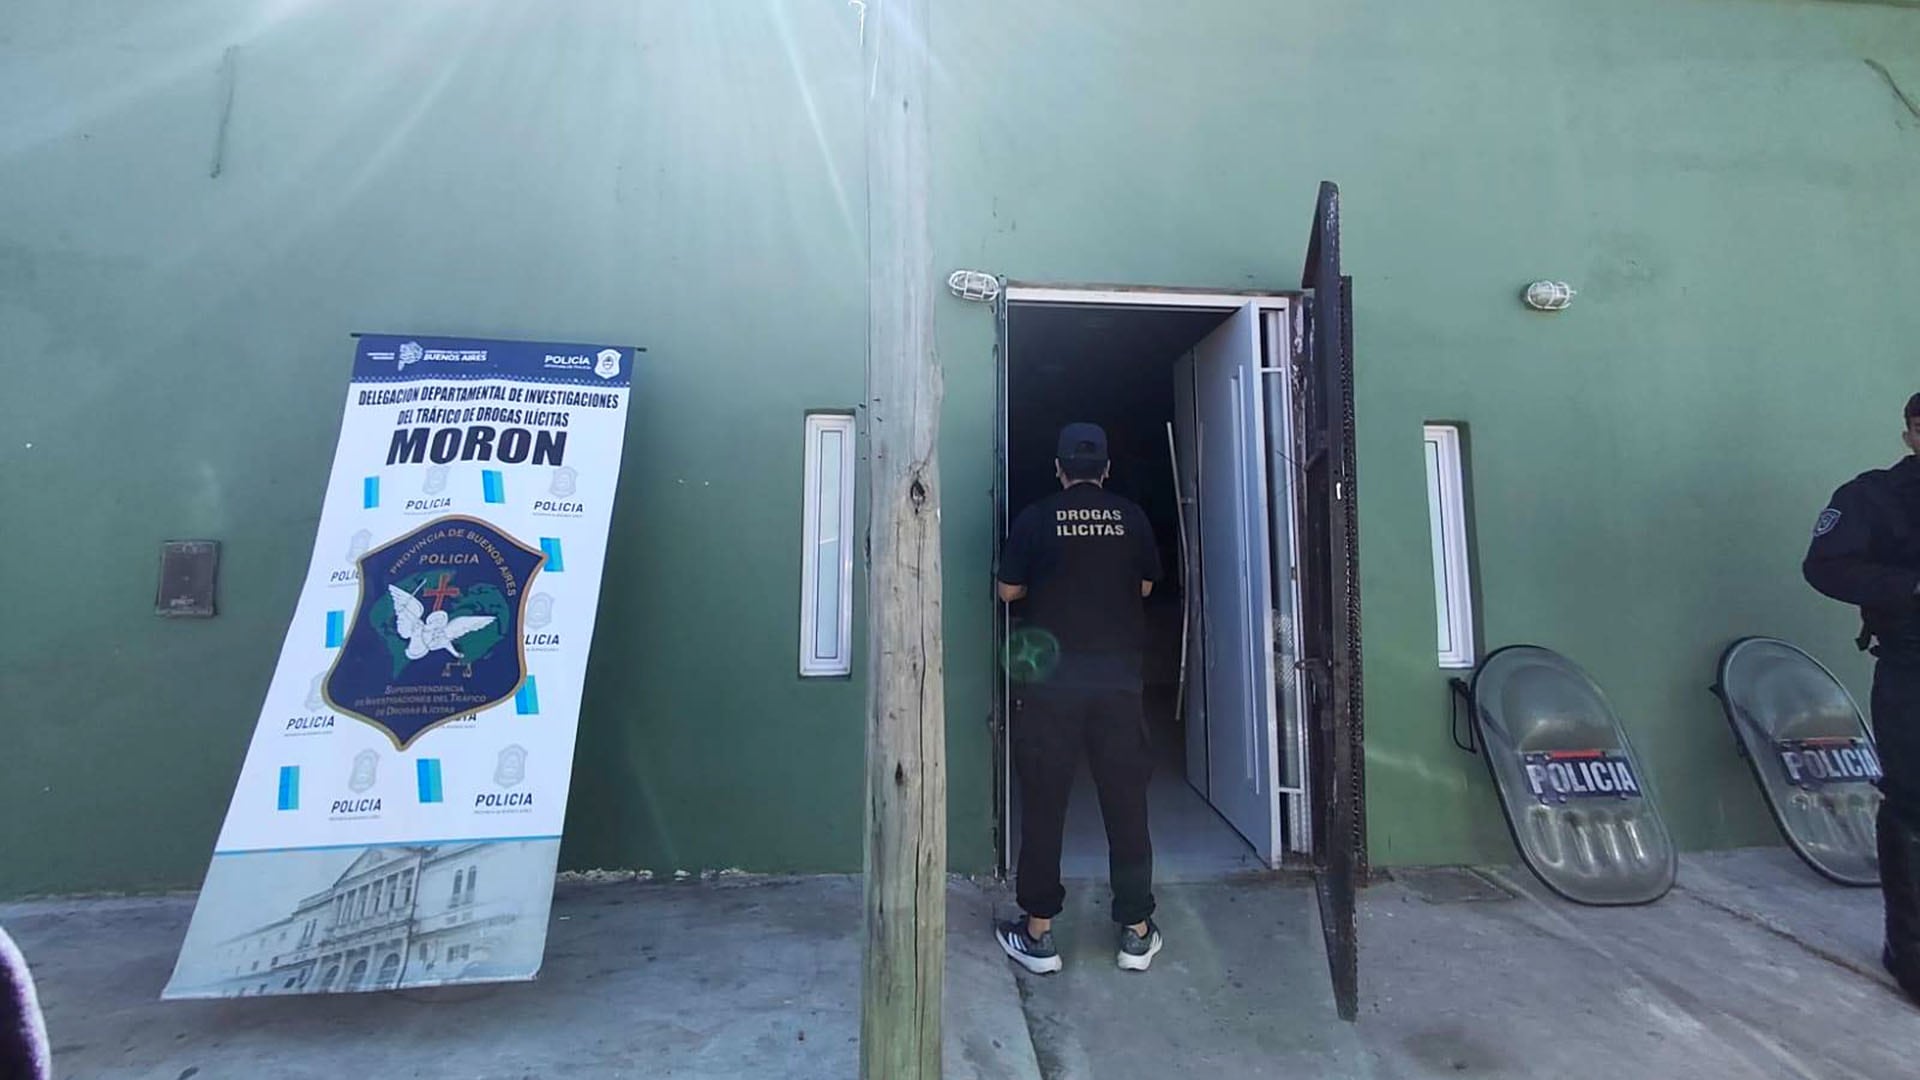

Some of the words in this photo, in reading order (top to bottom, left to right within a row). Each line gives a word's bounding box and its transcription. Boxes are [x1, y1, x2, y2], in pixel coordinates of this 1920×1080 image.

[423, 353, 460, 361] BUENOS
[420, 386, 506, 402] DEPARTAMENTAL
[508, 387, 524, 402] DE
[524, 389, 619, 409] INVESTIGACIONES
[397, 409, 414, 425] DEL
[415, 406, 462, 424] TRÁFICO
[462, 408, 476, 422] DE
[475, 407, 522, 424] DROGAS
[523, 408, 570, 428] ILÍCITAS
[386, 426, 567, 467] MORON
[405, 498, 451, 510] POLICIA
[534, 501, 584, 513] POLICIA
[1056, 509, 1122, 521] DROGAS
[1056, 524, 1125, 536] ILICITAS
[390, 529, 445, 574] PROVINCIA
[448, 528, 465, 537] DE
[466, 530, 504, 566] BUENOS
[499, 565, 517, 597] AIRES
[419, 553, 480, 565] POLICIA
[525, 634, 560, 646] LICIA
[286, 716, 335, 730] POLICIA
[1781, 748, 1883, 780] POLICIA
[1526, 762, 1637, 795] POLICIA
[331, 798, 382, 814] POLICIA
[475, 793, 533, 807] POLICIA
